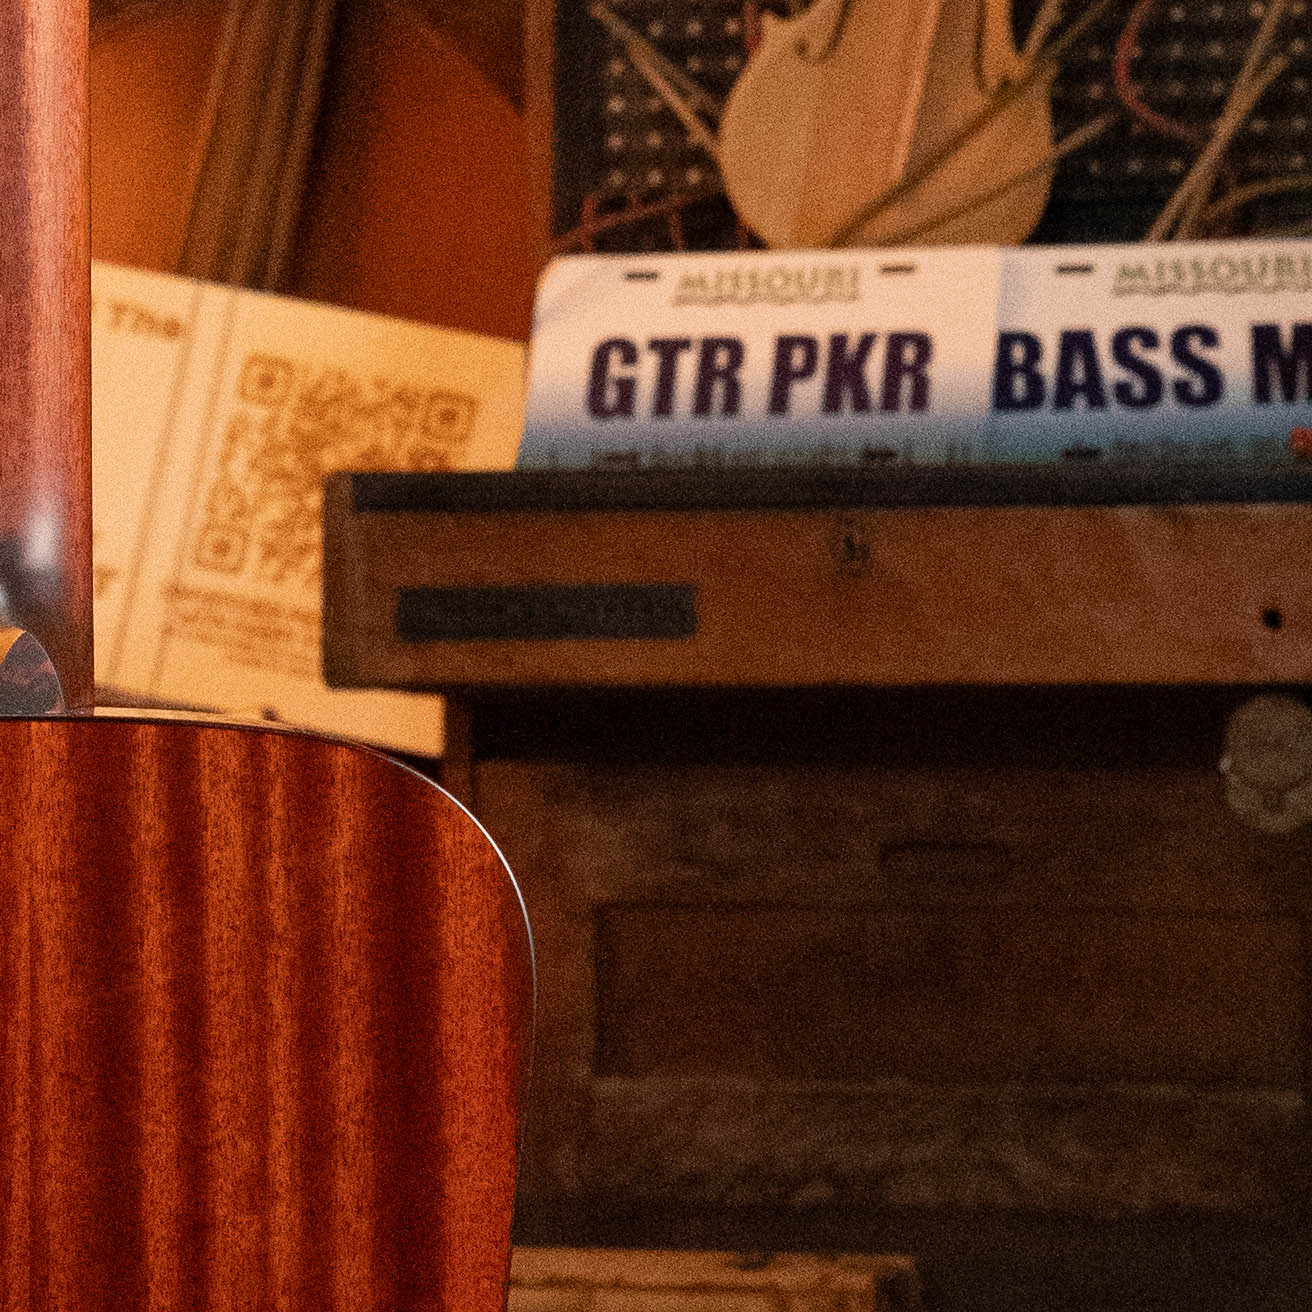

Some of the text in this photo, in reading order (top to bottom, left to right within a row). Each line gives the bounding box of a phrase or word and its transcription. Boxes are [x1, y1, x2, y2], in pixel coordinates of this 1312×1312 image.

[674, 264, 861, 307] MISSOURI
[586, 326, 936, 423] GTR PKR
[992, 323, 1227, 414] BASS
